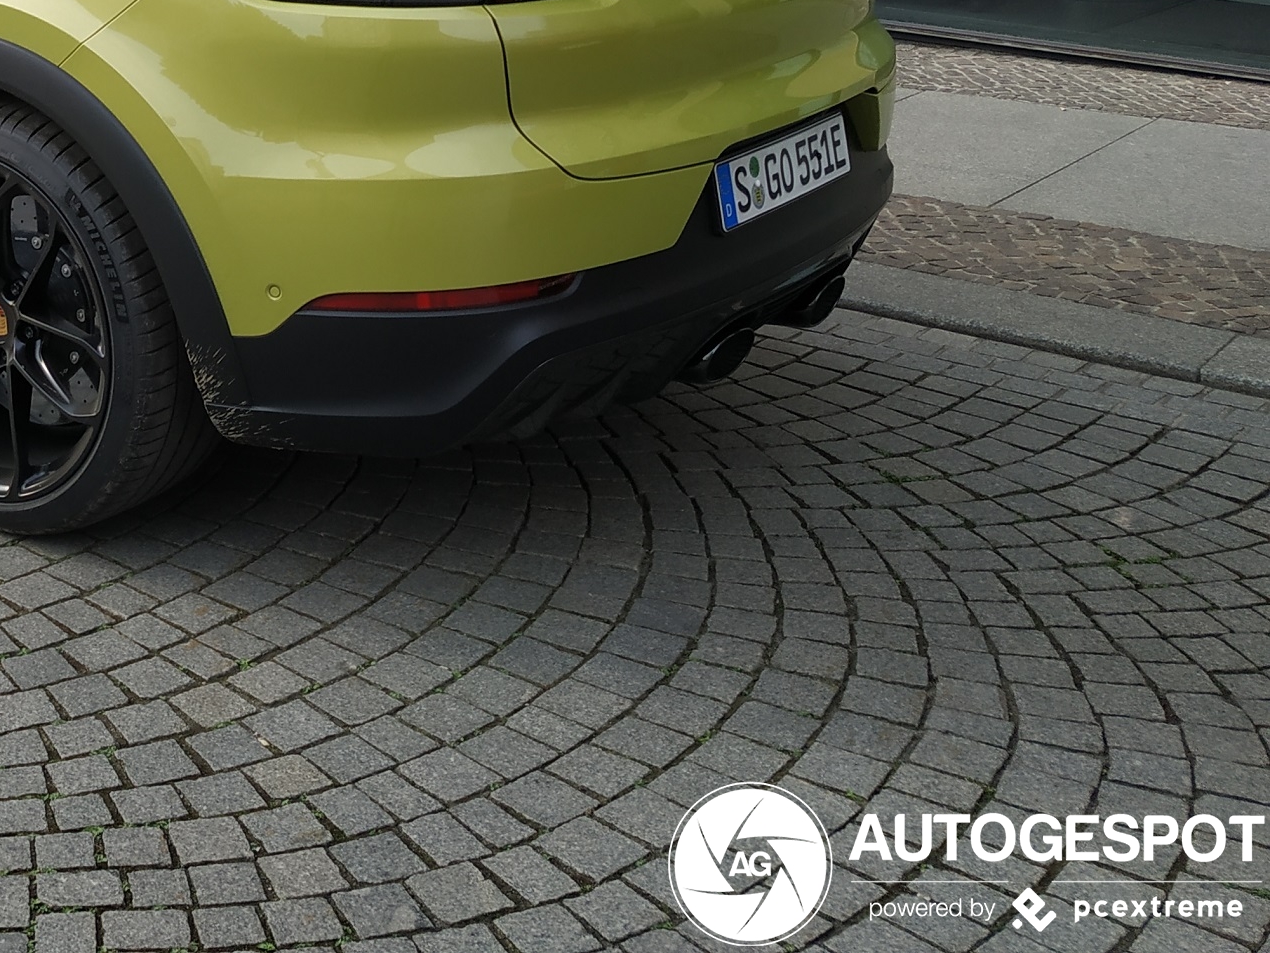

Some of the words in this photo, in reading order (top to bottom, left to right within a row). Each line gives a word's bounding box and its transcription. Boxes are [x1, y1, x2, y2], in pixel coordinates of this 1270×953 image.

[725, 203, 733, 218] D
[734, 165, 752, 213] S
[764, 147, 795, 200] GO
[795, 123, 847, 186] 551E
[80, 213, 129, 320] MICHELIN
